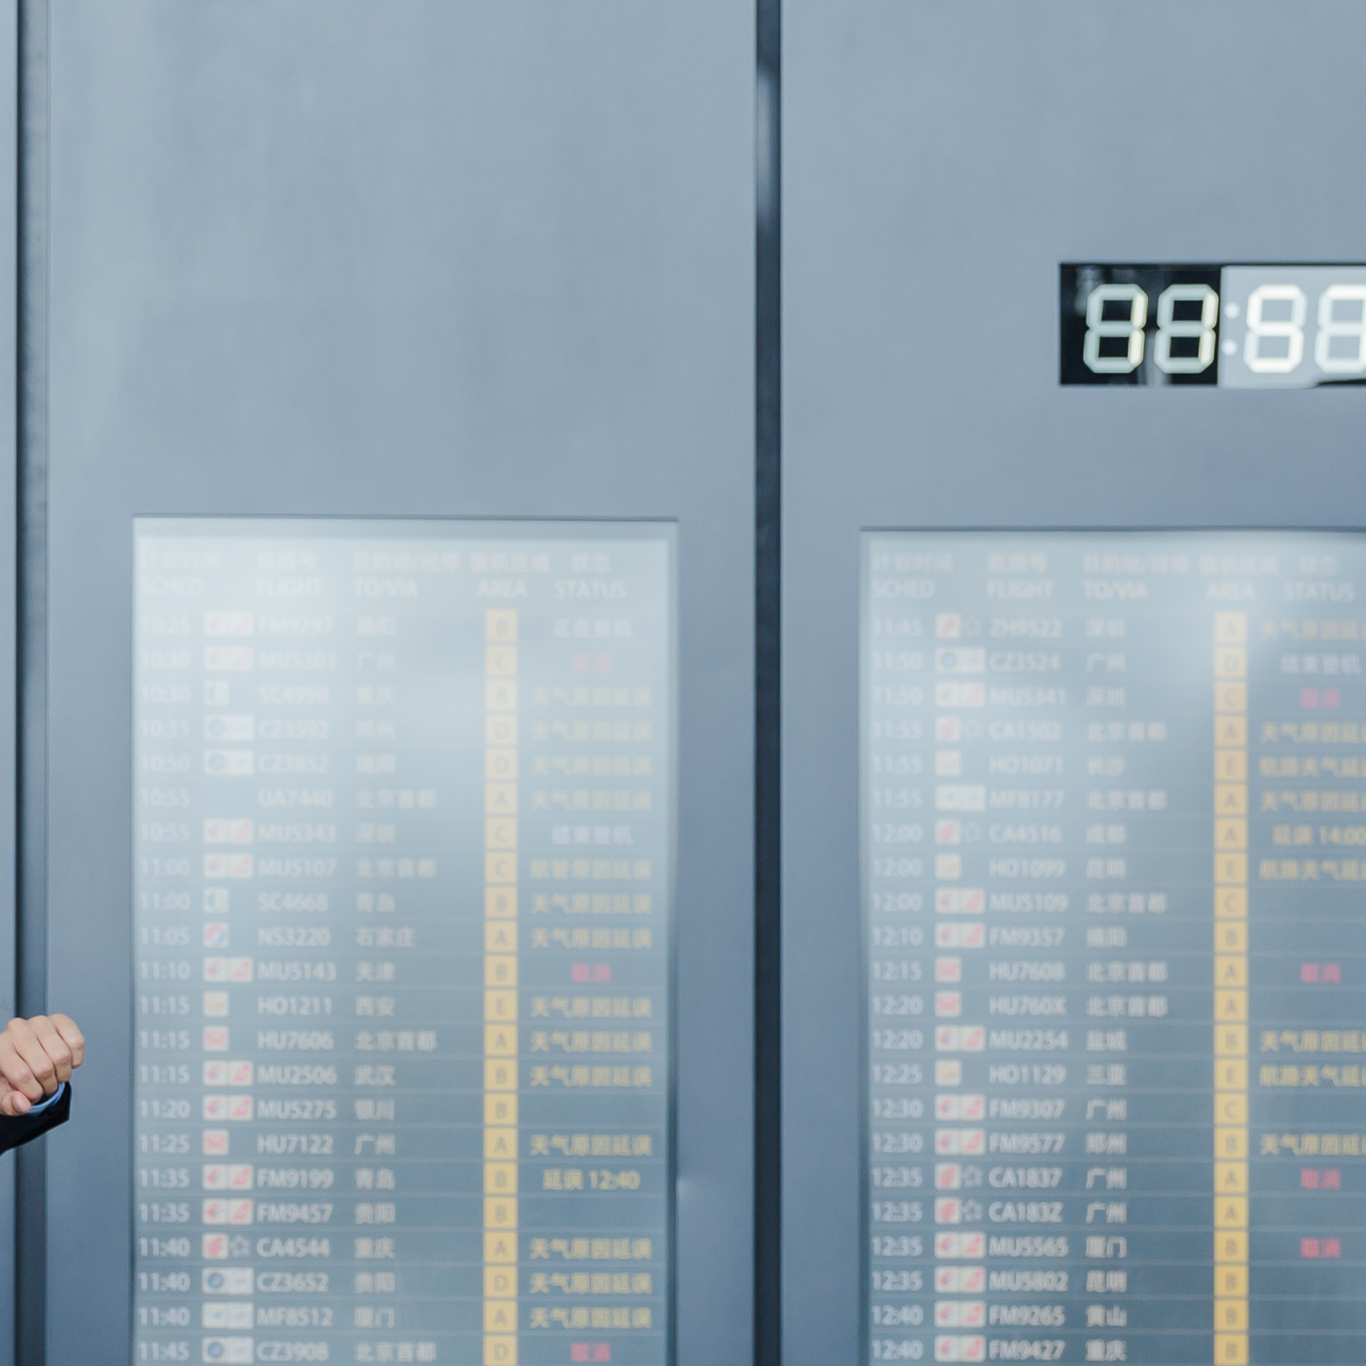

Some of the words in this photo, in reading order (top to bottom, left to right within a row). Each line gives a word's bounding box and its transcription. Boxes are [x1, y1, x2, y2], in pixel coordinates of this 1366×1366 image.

[255, 579, 323, 598] FLIGHT
[554, 580, 627, 599] STATUS
[986, 580, 1054, 599] FLIGHT
[141, 961, 191, 978] 11:10
[257, 961, 335, 980] MU5143
[356, 962, 394, 980] 天津
[141, 996, 190, 1013] 11:15
[257, 996, 331, 1014] HO1211
[356, 996, 394, 1015] 西安
[873, 995, 923, 1014] 12:20
[989, 996, 1065, 1014] HU760X
[1086, 996, 1167, 1016] 北京首都
[141, 1031, 190, 1048] 11:15
[256, 1030, 333, 1049] HU7606
[356, 1031, 436, 1050] 北京首都
[873, 1030, 923, 1049] 12:20
[989, 1030, 1068, 1049] MU2254
[141, 1065, 190, 1083] 11:15
[256, 1065, 336, 1084] MU2506
[873, 1064, 922, 1083] 12:25
[989, 1065, 1066, 1083] HO1129
[140, 1100, 190, 1118] 11:20
[257, 1100, 336, 1118] MU5275
[873, 1099, 923, 1118] 12:30
[1086, 1099, 1126, 1118] 广州
[140, 1134, 189, 1152] 11:25
[256, 1134, 333, 1153] HU7122
[355, 1135, 395, 1153] 广州
[873, 1133, 923, 1152] 12:30
[139, 1168, 189, 1187] 11:35
[256, 1169, 333, 1187] FM9199
[355, 1169, 394, 1188] 青岛
[590, 1170, 640, 1190] 12:40
[873, 1167, 922, 1187] 12:35
[1086, 1168, 1126, 1187] 广州
[140, 1203, 189, 1222] 11:35
[256, 1203, 332, 1222] FM9457
[873, 1202, 922, 1222] 12:35
[1086, 1203, 1126, 1222] 广州
[140, 1238, 191, 1256] 11:40
[256, 1239, 330, 1257] CA4544
[355, 1238, 393, 1258] 重庆
[873, 1236, 922, 1256] 12:35
[989, 1237, 1068, 1256] MU5565
[140, 1273, 190, 1291] 11:40
[256, 1273, 328, 1292] CZ3652
[873, 1271, 922, 1290] 12:35
[139, 1307, 190, 1325] 11:40
[873, 1306, 923, 1325] 12:40
[989, 1306, 1064, 1325] FM9265
[1087, 1306, 1126, 1326] 黄山
[139, 1342, 189, 1360] 11:45
[356, 1342, 436, 1361] 北京首都
[873, 1340, 923, 1359] 12:40
[1087, 1340, 1125, 1361] 重庆
